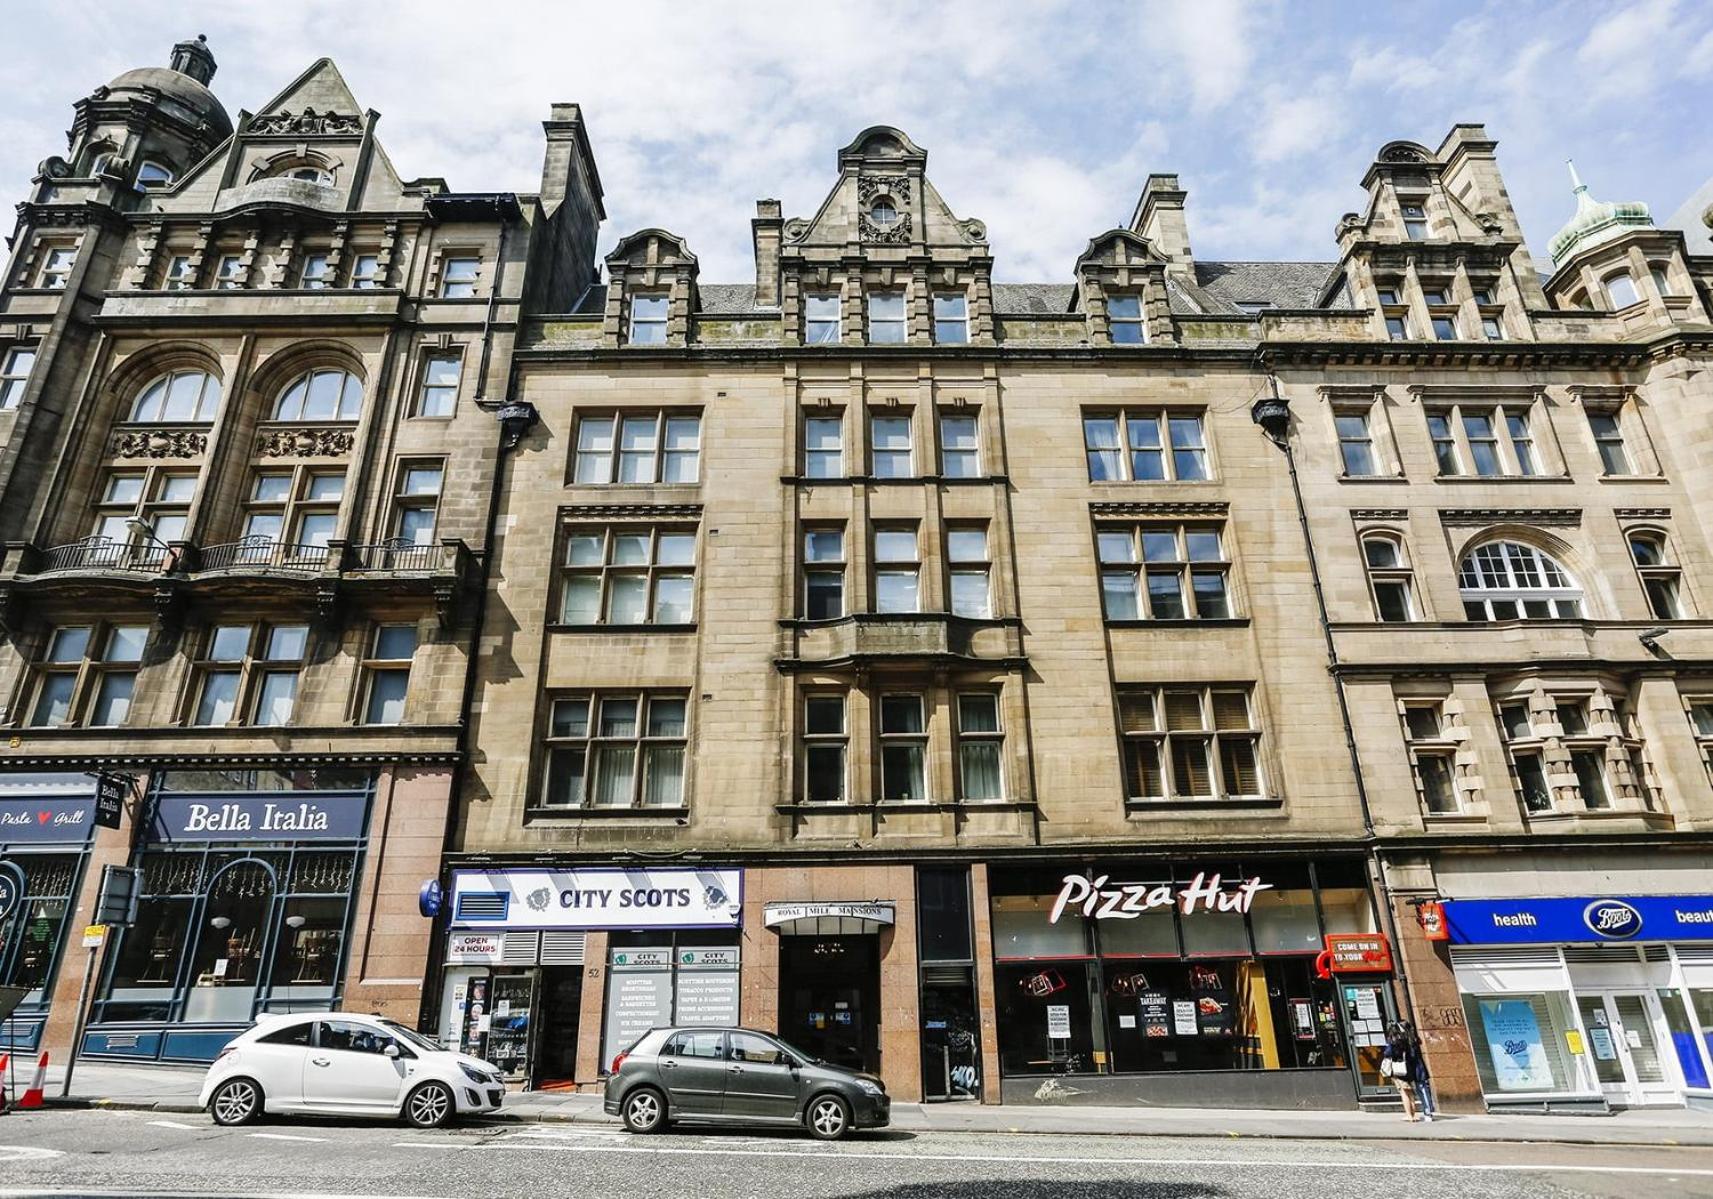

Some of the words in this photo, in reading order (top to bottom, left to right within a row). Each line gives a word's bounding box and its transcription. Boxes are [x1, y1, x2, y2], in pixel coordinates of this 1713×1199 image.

[102, 784, 119, 799] Bella
[100, 798, 118, 812] Italia
[0, 811, 33, 825] Pasta
[54, 810, 84, 827] Grill
[183, 804, 251, 831] Bella
[260, 804, 328, 830] Italia
[560, 889, 612, 908] CITY
[619, 888, 691, 908] SCOTS
[1050, 874, 1176, 925] Pizza
[1178, 871, 1274, 916] Hut
[777, 908, 801, 916] ROYAL
[809, 907, 829, 915] MILE
[838, 906, 882, 915] MANSIONS
[1494, 913, 1537, 927] health
[1596, 908, 1632, 929] Boots
[464, 937, 489, 945] OPEN
[1337, 943, 1358, 951] COME
[1358, 942, 1370, 950] ON
[1369, 942, 1379, 950] IN
[454, 945, 466, 953] 24
[466, 945, 496, 953] HOURS
[1334, 953, 1343, 962] TO
[1343, 953, 1364, 961] YOUR
[1504, 1040, 1528, 1055] Boots
